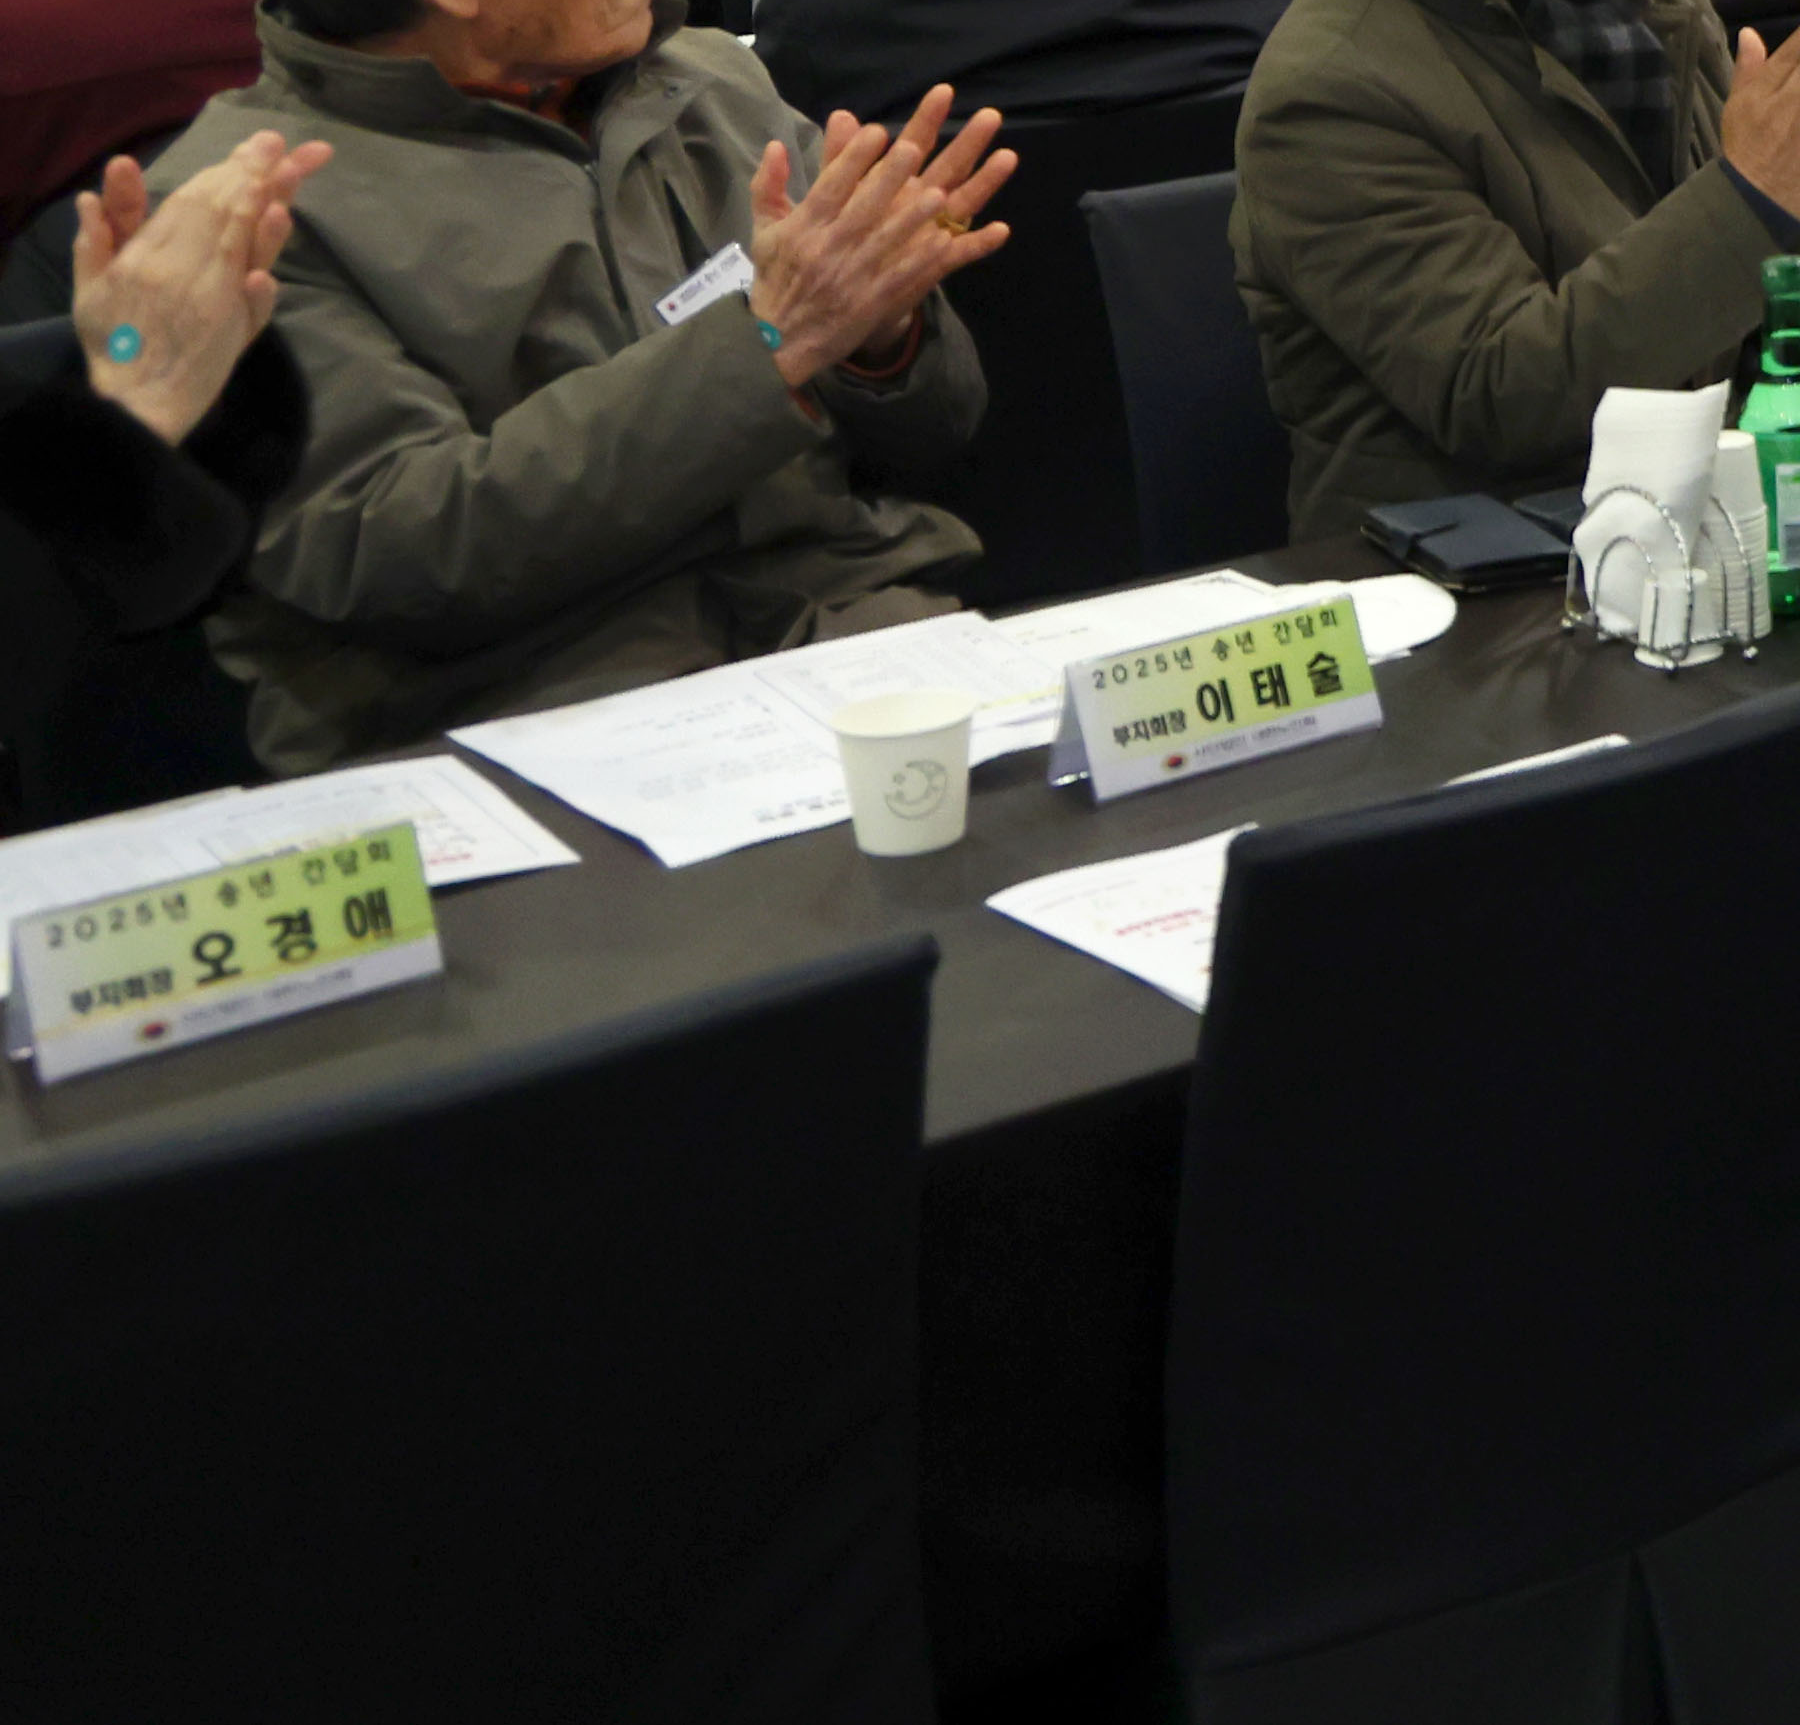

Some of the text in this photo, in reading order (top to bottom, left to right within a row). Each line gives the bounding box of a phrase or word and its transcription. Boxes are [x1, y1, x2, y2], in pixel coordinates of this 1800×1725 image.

[1091, 608, 1338, 690] 2025년 송년 간담회
[46, 891, 189, 949] 2025년
